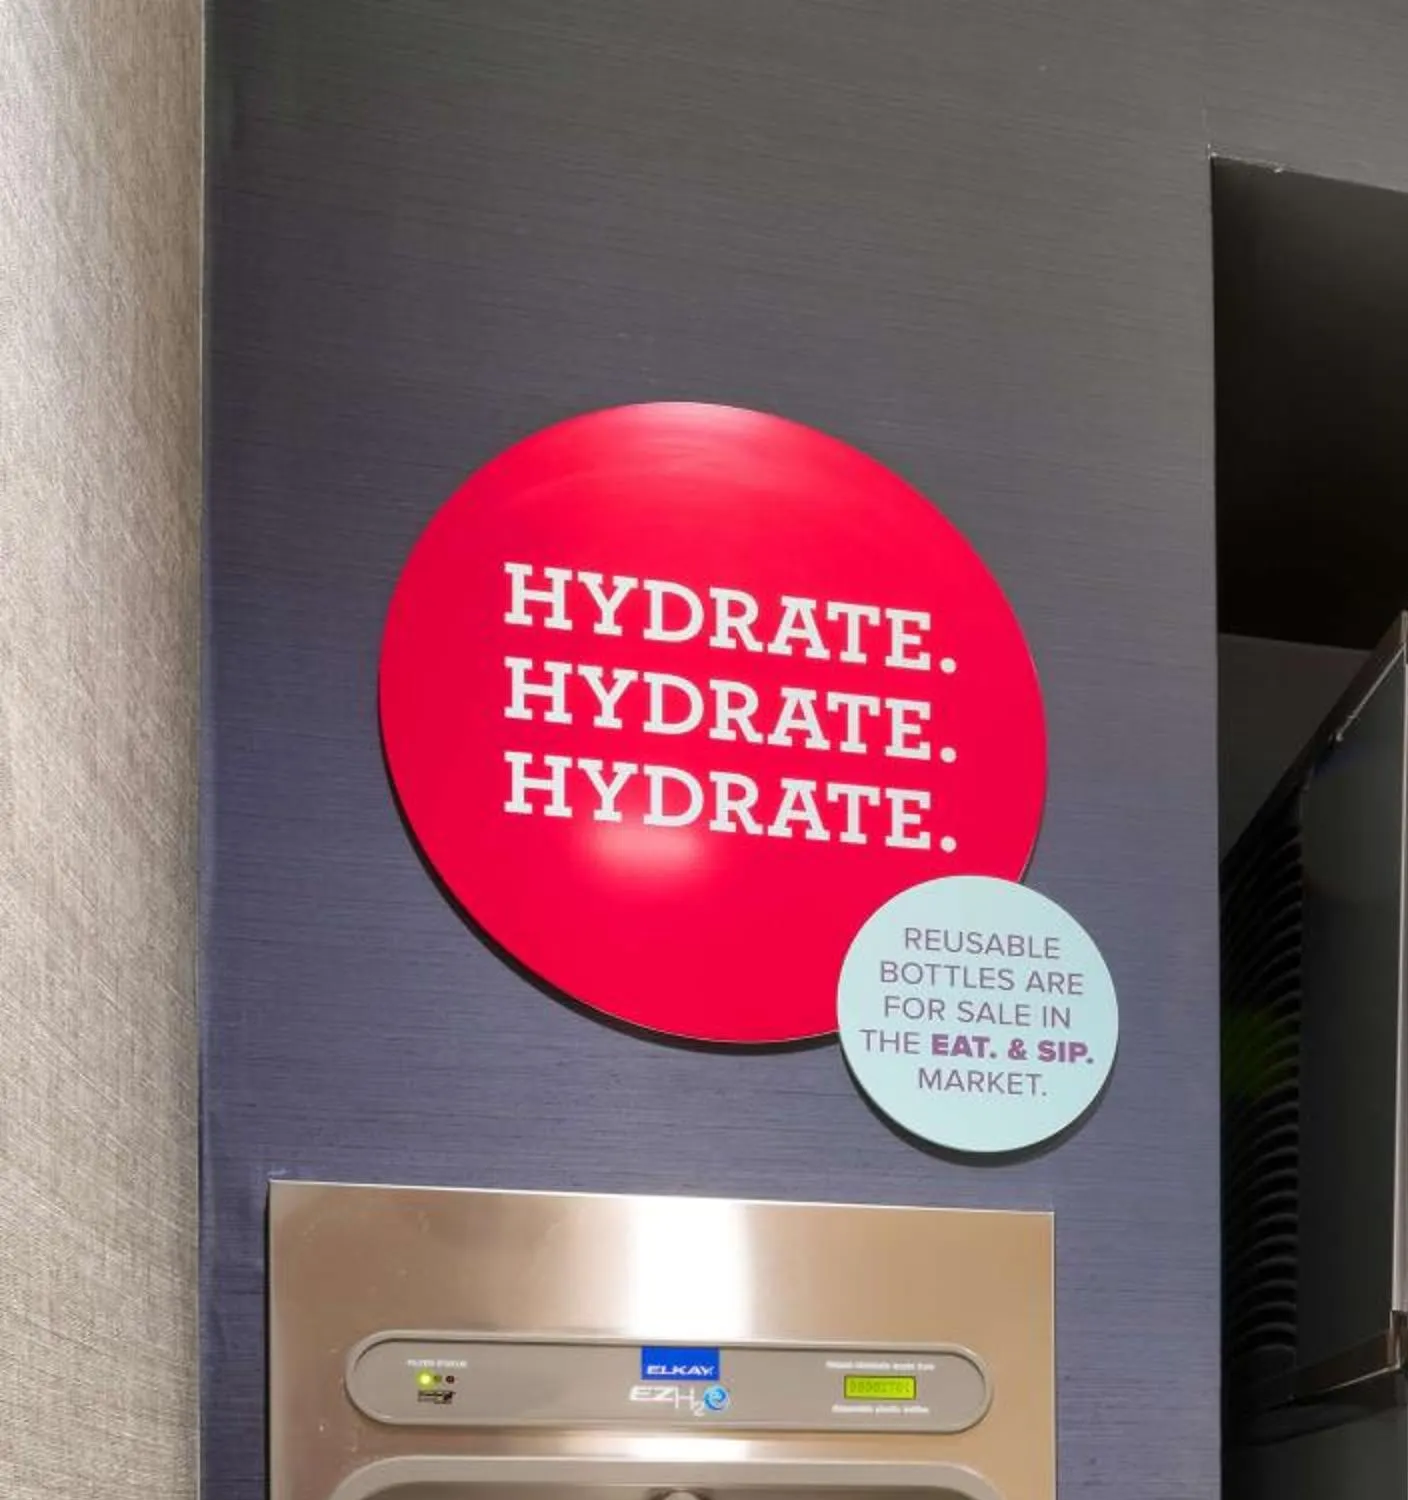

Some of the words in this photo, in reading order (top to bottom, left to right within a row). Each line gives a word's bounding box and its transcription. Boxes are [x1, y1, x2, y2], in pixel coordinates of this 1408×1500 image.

[505, 562, 956, 673] HYDRATE.
[505, 657, 956, 763] HYDRATE.
[505, 751, 956, 852] HYDRATE.
[904, 927, 1061, 960] REUSABLE
[880, 960, 1016, 991] BOTTLES
[1025, 970, 1084, 996] ARE
[884, 995, 946, 1021] FOR
[956, 999, 1031, 1027] SALE
[1042, 1005, 1071, 1030] IN
[859, 1028, 921, 1055] THE
[931, 1033, 998, 1060] EAT.
[1007, 1037, 1029, 1061] &
[1037, 1039, 1095, 1065] SIP.
[918, 1067, 1047, 1097] MARKET.
[647, 1365, 716, 1376] ELKAY
